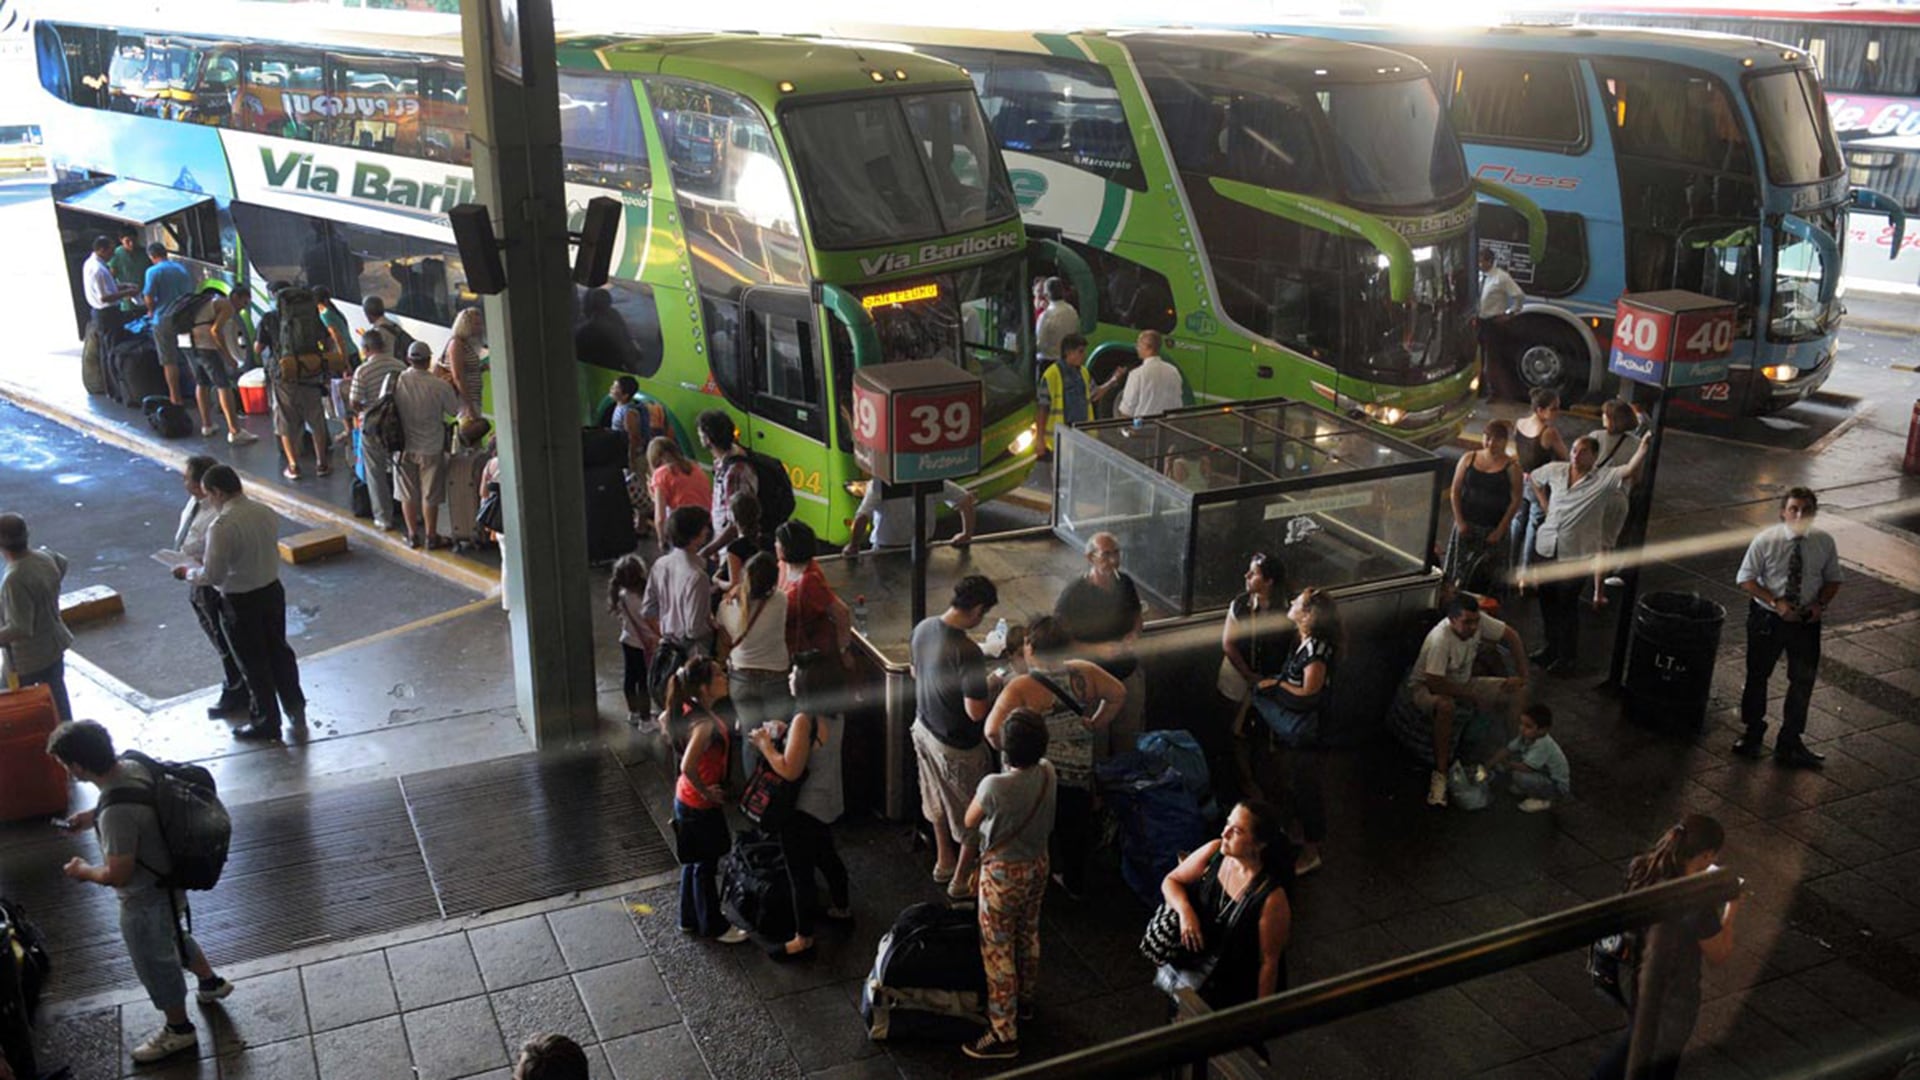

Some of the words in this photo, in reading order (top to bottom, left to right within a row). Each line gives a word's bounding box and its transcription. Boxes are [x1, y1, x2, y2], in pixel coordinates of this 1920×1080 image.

[1080, 157, 1132, 170] Marcopolo
[918, 232, 1018, 263] Bariloche
[1616, 312, 1658, 352] 40
[1686, 319, 1732, 355] 40
[909, 401, 971, 446] 39
